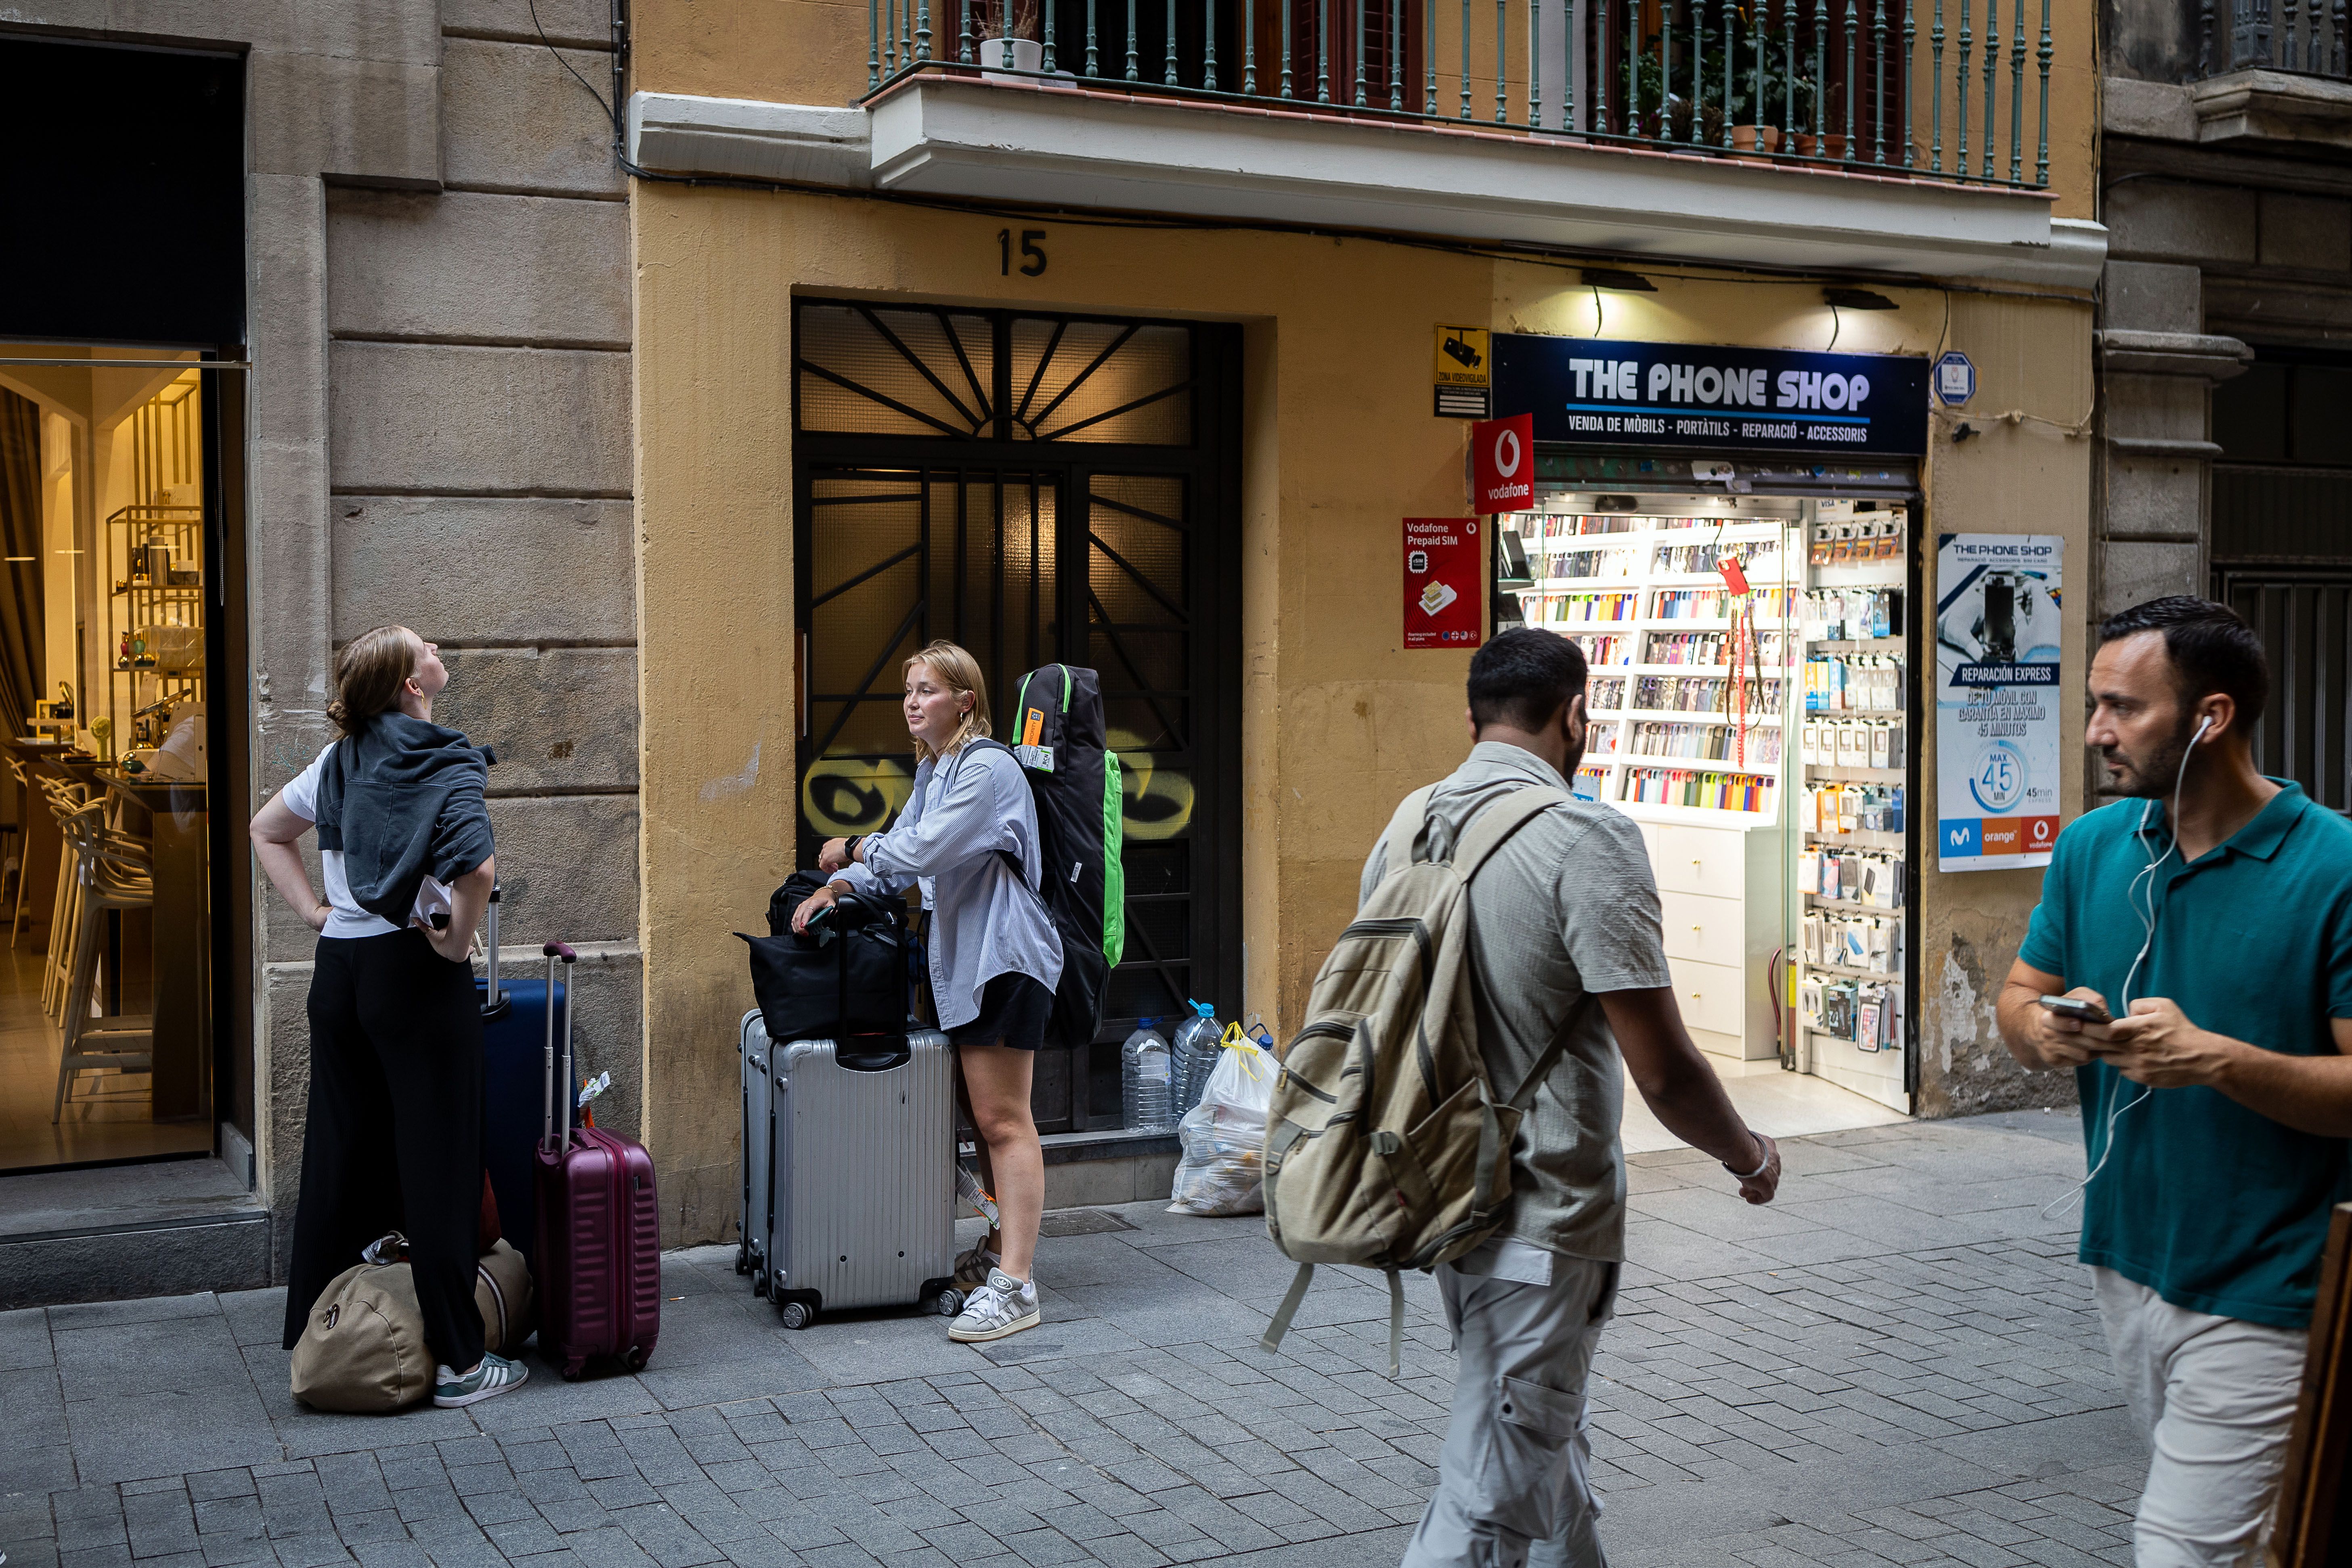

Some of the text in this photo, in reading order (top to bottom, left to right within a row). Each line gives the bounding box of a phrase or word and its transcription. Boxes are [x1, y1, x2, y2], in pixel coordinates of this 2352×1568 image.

[998, 228, 1047, 277] 15
[1438, 371, 1486, 383] ZONA VIDEOVIGILADA
[1569, 358, 1870, 411] THE PHONE SHOP
[1569, 415, 1604, 431] VENDA
[1607, 417, 1620, 432] DE
[1624, 414, 1664, 433] MÒBILS
[1677, 418, 1729, 436] PORTÀTILS
[1742, 421, 1796, 439] REPARACIÓ
[1807, 426, 1867, 443] ACCESSORIS
[1488, 482, 1529, 500] vodafone
[1407, 523, 1449, 532] Vodafone
[1408, 536, 1457, 547] Prepaid SIM
[1954, 545, 2052, 556] THE PHONE SHOP
[1962, 665, 2051, 682] REPARACIÓN EXPRESS
[1968, 691, 1979, 706] DE
[1993, 688, 2018, 705] MÓVIL
[2020, 690, 2037, 705] CON
[2000, 706, 2011, 721] EN
[1028, 721, 1036, 744] PRIORITY
[1979, 721, 2027, 737] 45 MINUTOS
[1989, 754, 2007, 762] MAX
[1982, 763, 2013, 791] 45
[1994, 791, 2005, 801] MIN
[1984, 832, 2015, 843] orange
[981, 1198, 989, 1208] BCN
